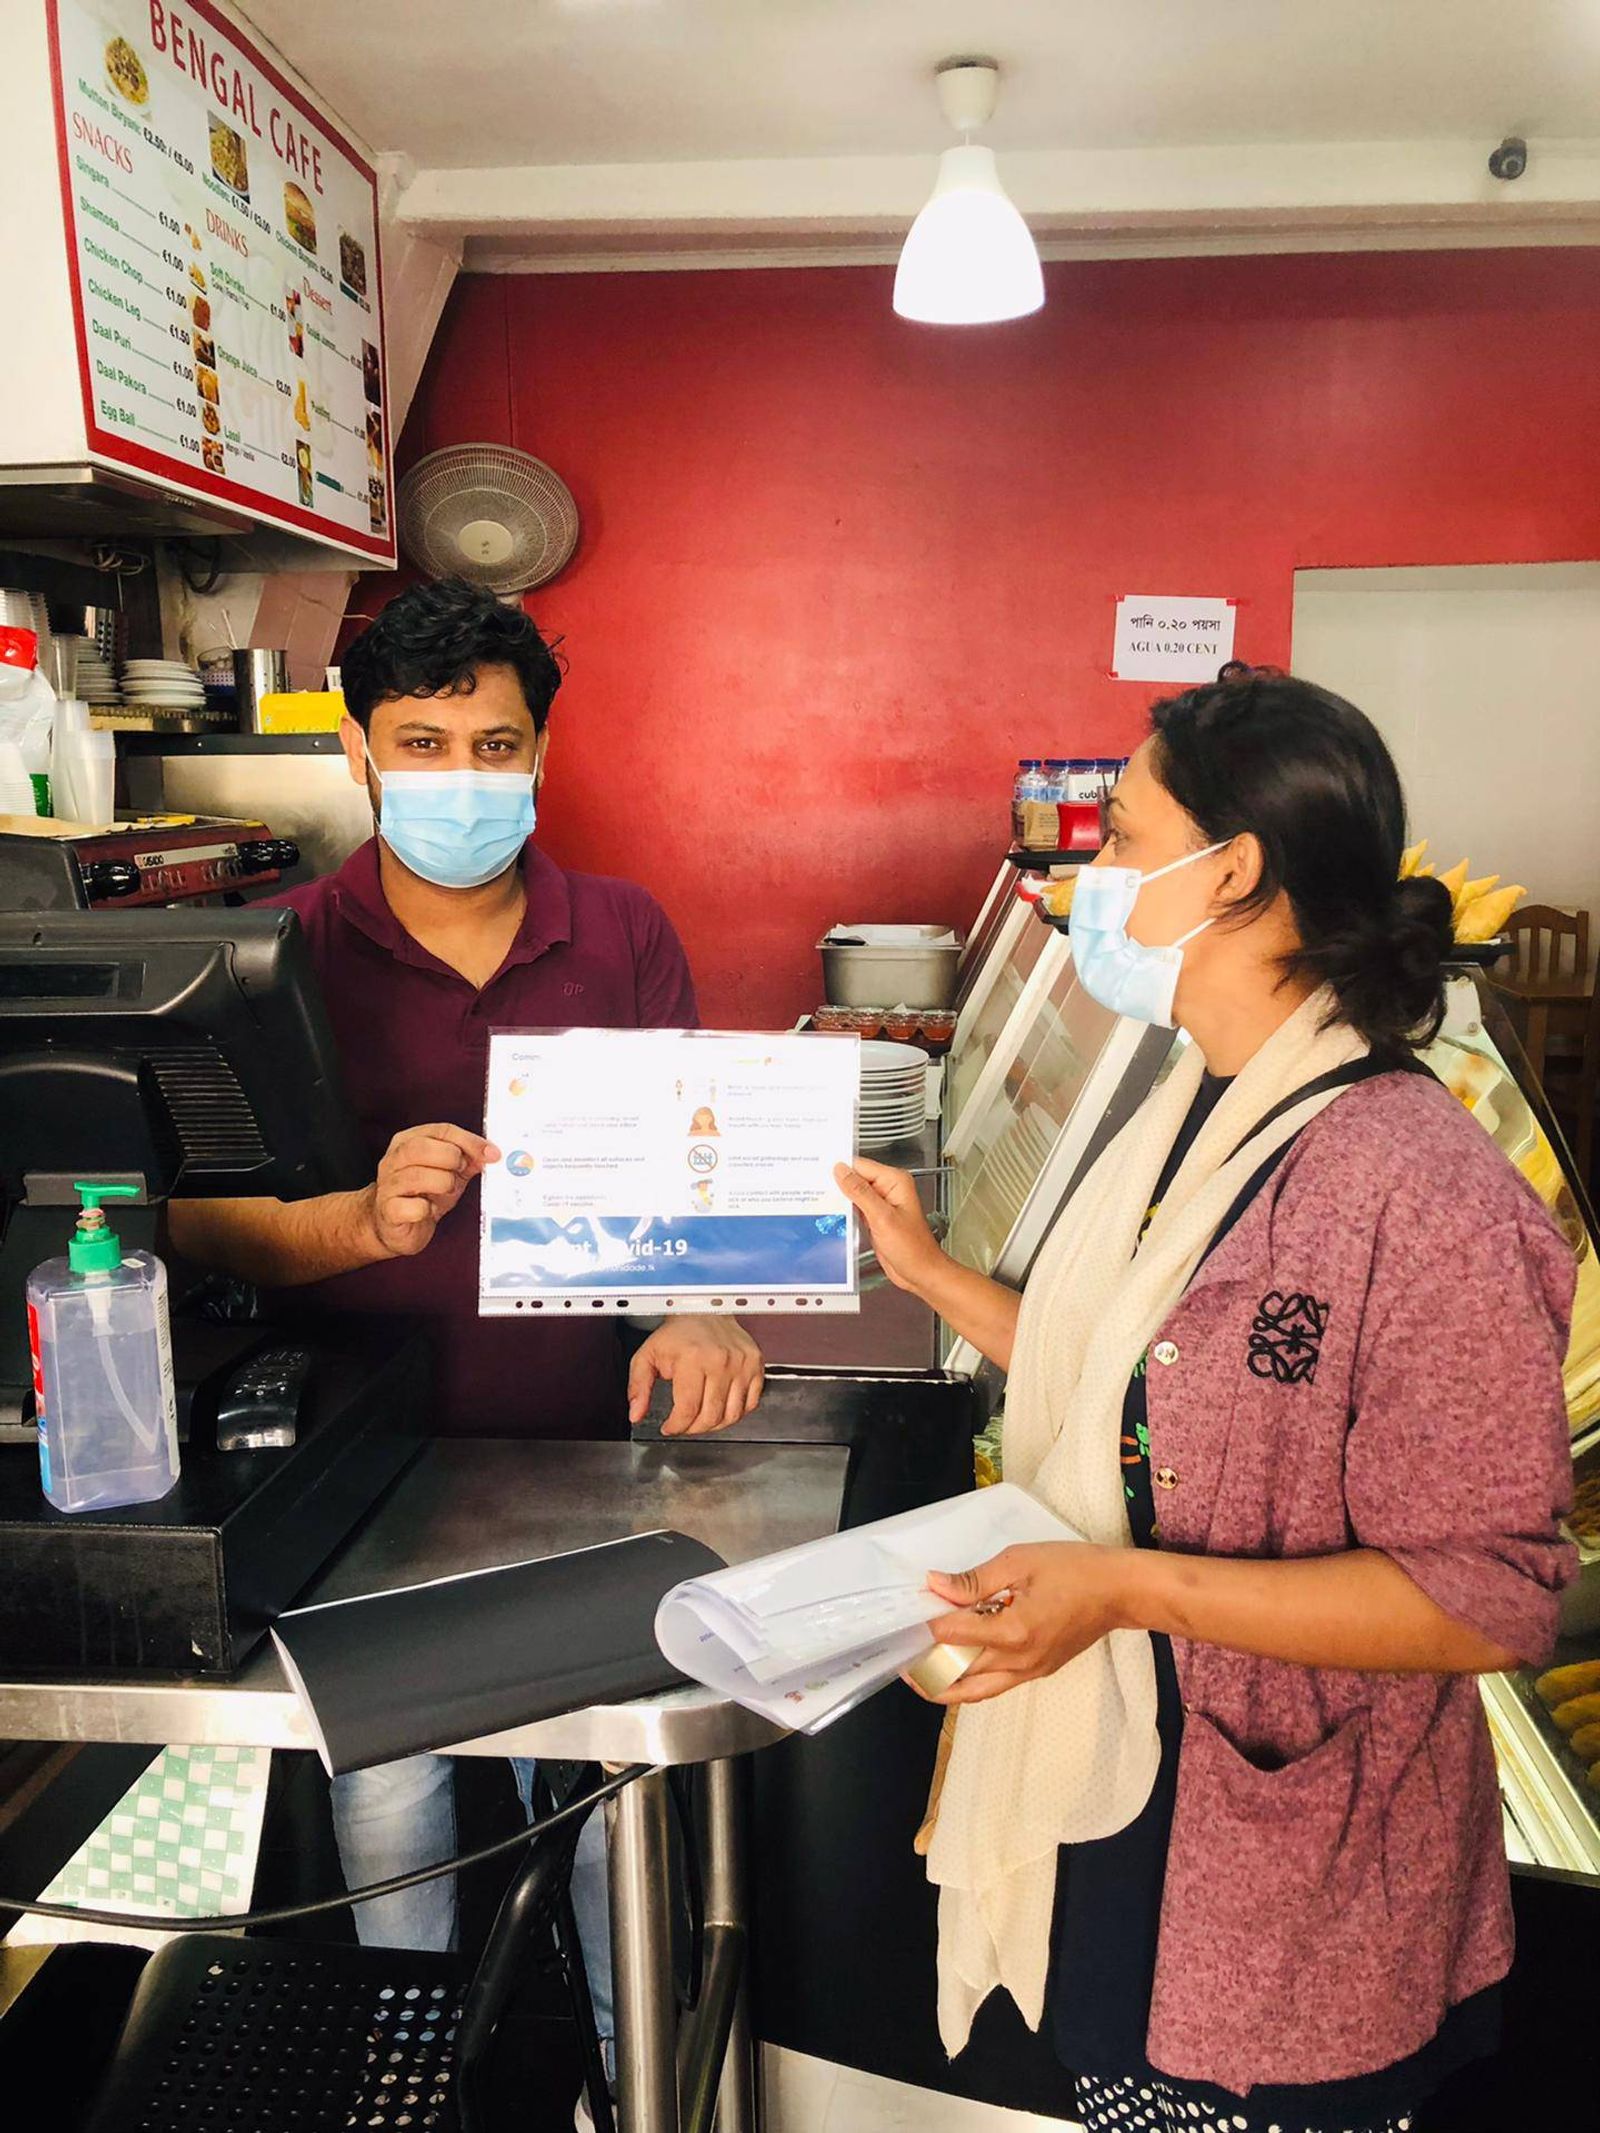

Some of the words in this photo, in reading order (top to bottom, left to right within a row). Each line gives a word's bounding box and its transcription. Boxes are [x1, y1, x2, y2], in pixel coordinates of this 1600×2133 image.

[150, 0, 262, 138] BENGAL
[269, 107, 324, 195] CAFE
[72, 111, 134, 174] SNACKS
[158, 211, 181, 235] €1.00
[204, 207, 249, 258] DRINKS
[84, 236, 120, 269] Chicken
[121, 259, 144, 285] Chop
[165, 286, 188, 310] €1.00
[162, 249, 184, 273] €1.00
[87, 278, 125, 310] Chicken
[124, 299, 142, 322] Leg
[169, 324, 191, 346] €1.50
[91, 318, 113, 342] Daal
[113, 330, 133, 350] Puri
[172, 361, 194, 382] €1.00
[95, 359, 118, 382] Daal
[117, 370, 148, 395] Pakora
[176, 397, 198, 418] €1.00
[100, 399, 118, 422] Egg
[118, 407, 136, 427] Ball
[179, 434, 201, 454] €1.00
[1128, 641, 1162, 653] AGUA
[1163, 642, 1185, 654] 0.20
[1186, 643, 1218, 655] CENT
[1129, 614, 1154, 629] পানি
[1157, 618, 1187, 631] ০.২০
[626, 1238, 688, 1257] vid-19
